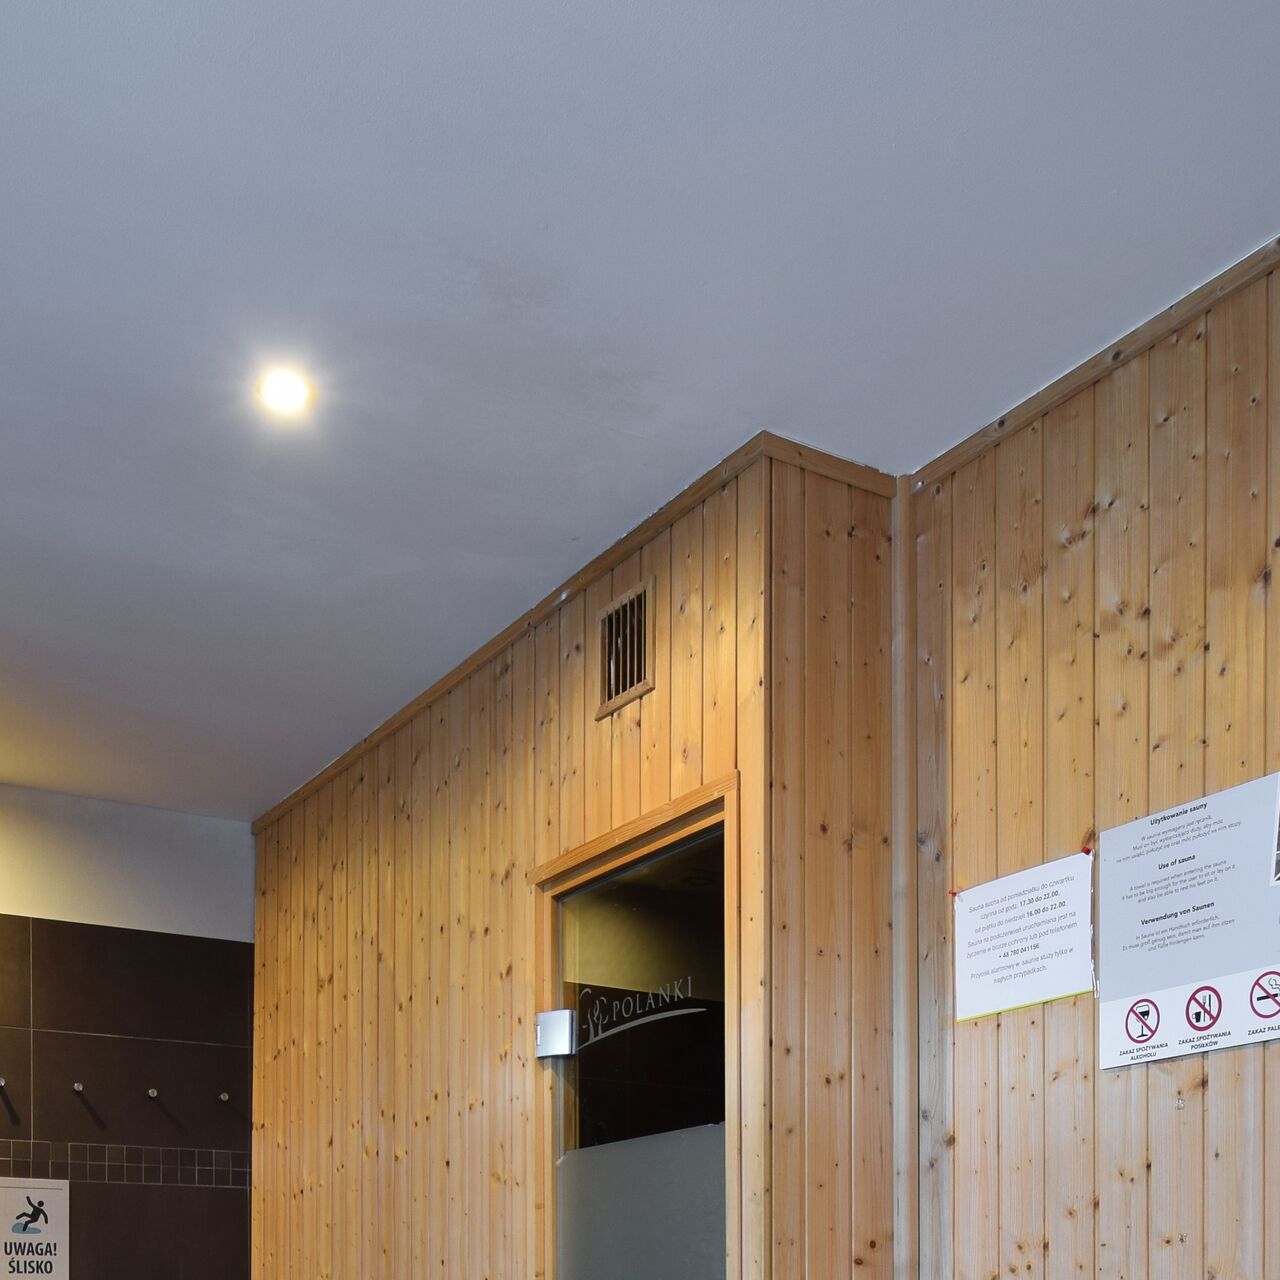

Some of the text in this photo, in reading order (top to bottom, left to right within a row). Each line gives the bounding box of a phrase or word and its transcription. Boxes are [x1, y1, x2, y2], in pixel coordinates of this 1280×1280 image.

[1189, 802, 1208, 813] sauny
[1158, 854, 1196, 870] Use of sauna
[1140, 902, 1215, 926] Verwendung von Saunen
[613, 976, 693, 1021] POLANKI
[4, 1241, 57, 1256] UWAGA!
[8, 1257, 53, 1274] ŚLISKO
